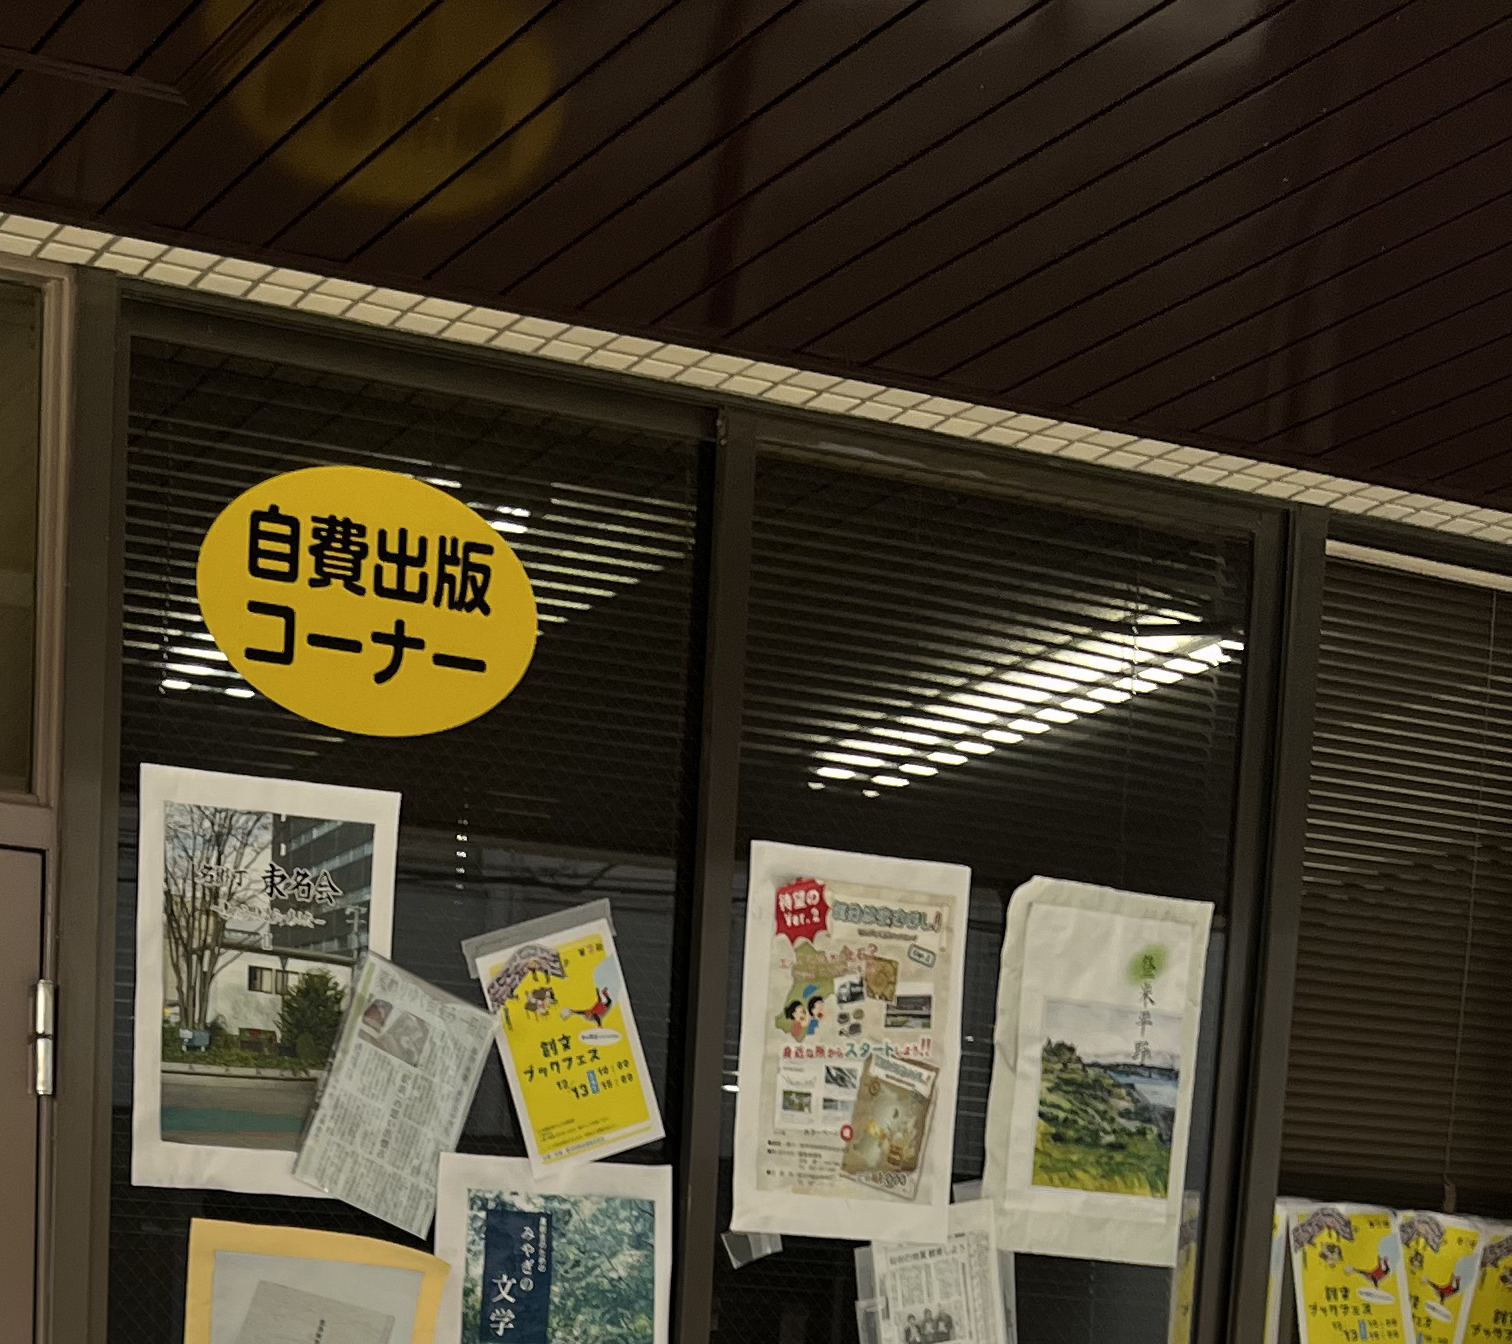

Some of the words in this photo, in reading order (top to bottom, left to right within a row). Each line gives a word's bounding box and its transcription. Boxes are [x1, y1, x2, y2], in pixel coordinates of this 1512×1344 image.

[247, 503, 494, 617] 自費出版
[244, 600, 487, 685] コーナー
[520, 1225, 536, 1292] みやぎの
[489, 1272, 518, 1337] 文学
